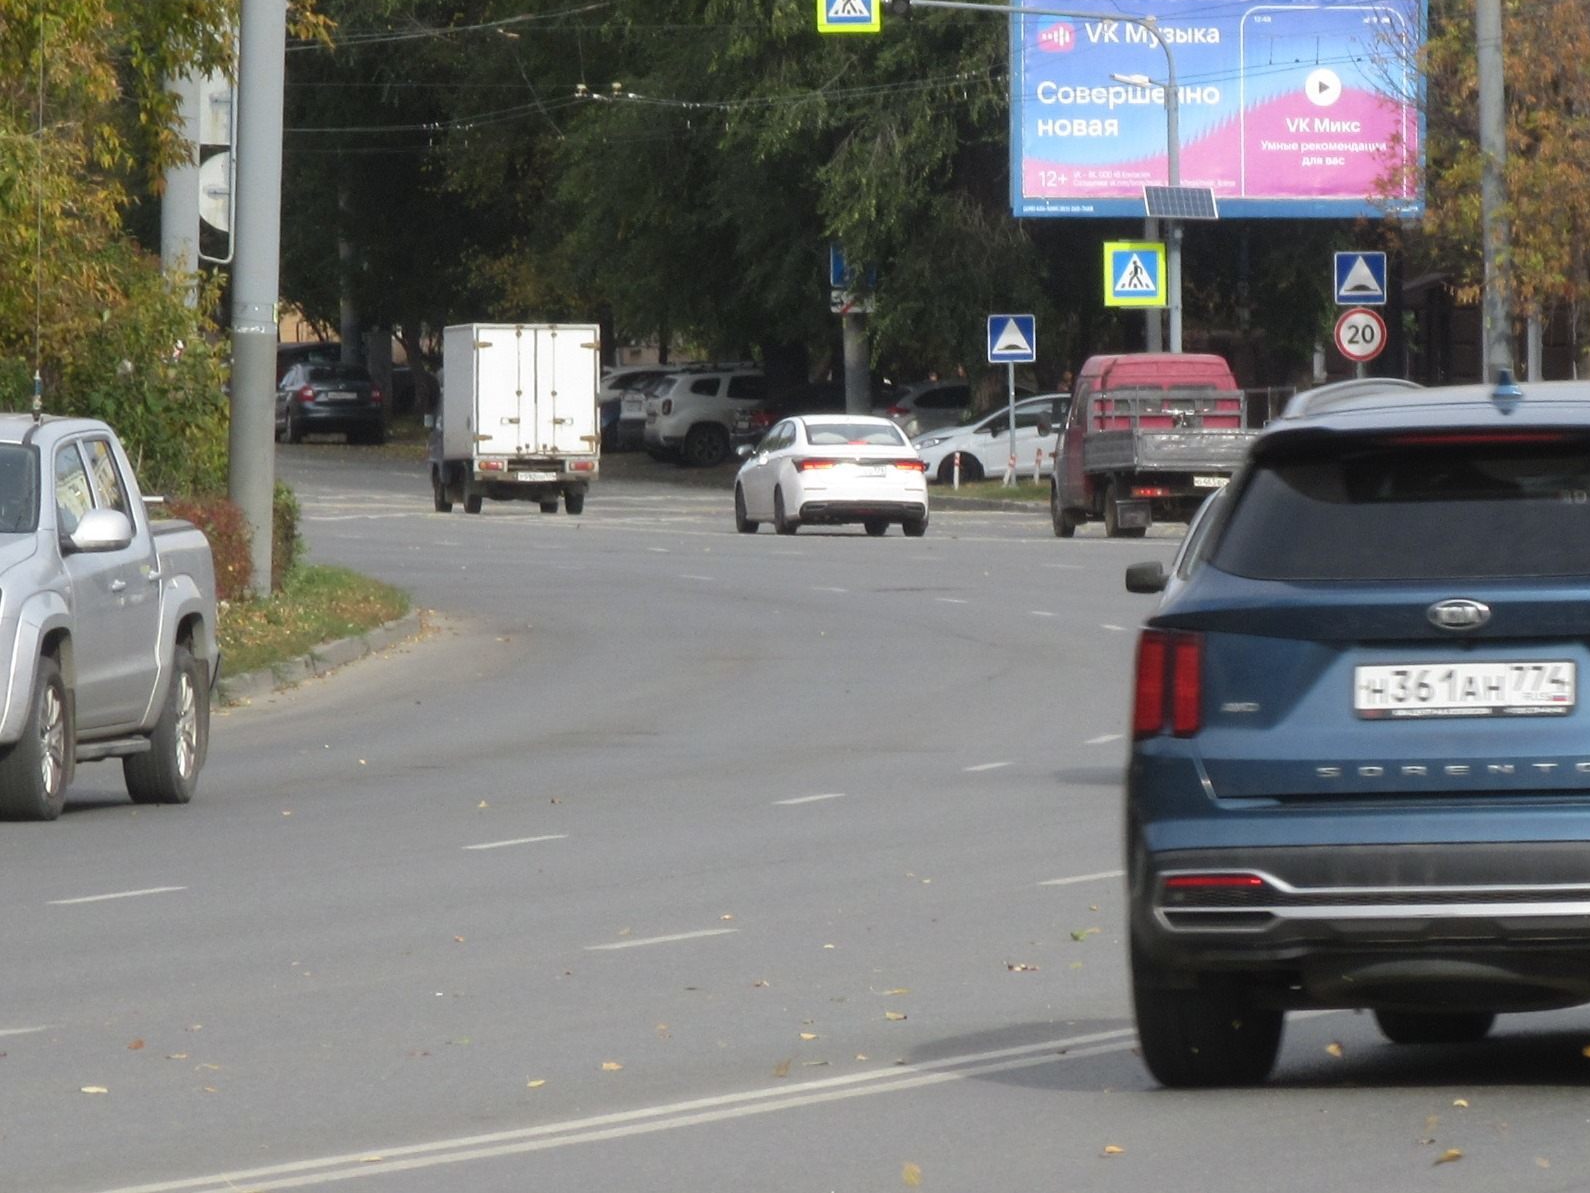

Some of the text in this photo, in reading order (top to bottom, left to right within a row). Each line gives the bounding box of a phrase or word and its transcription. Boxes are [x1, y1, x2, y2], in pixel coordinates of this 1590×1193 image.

[1085, 22, 1220, 48] VK Музыка
[1037, 118, 1119, 137] новая
[1286, 118, 1361, 133] VK Микс
[1260, 140, 1299, 151] Умные
[1302, 157, 1345, 166] для вас
[1039, 171, 1068, 187] 12+
[1347, 324, 1375, 344] 20
